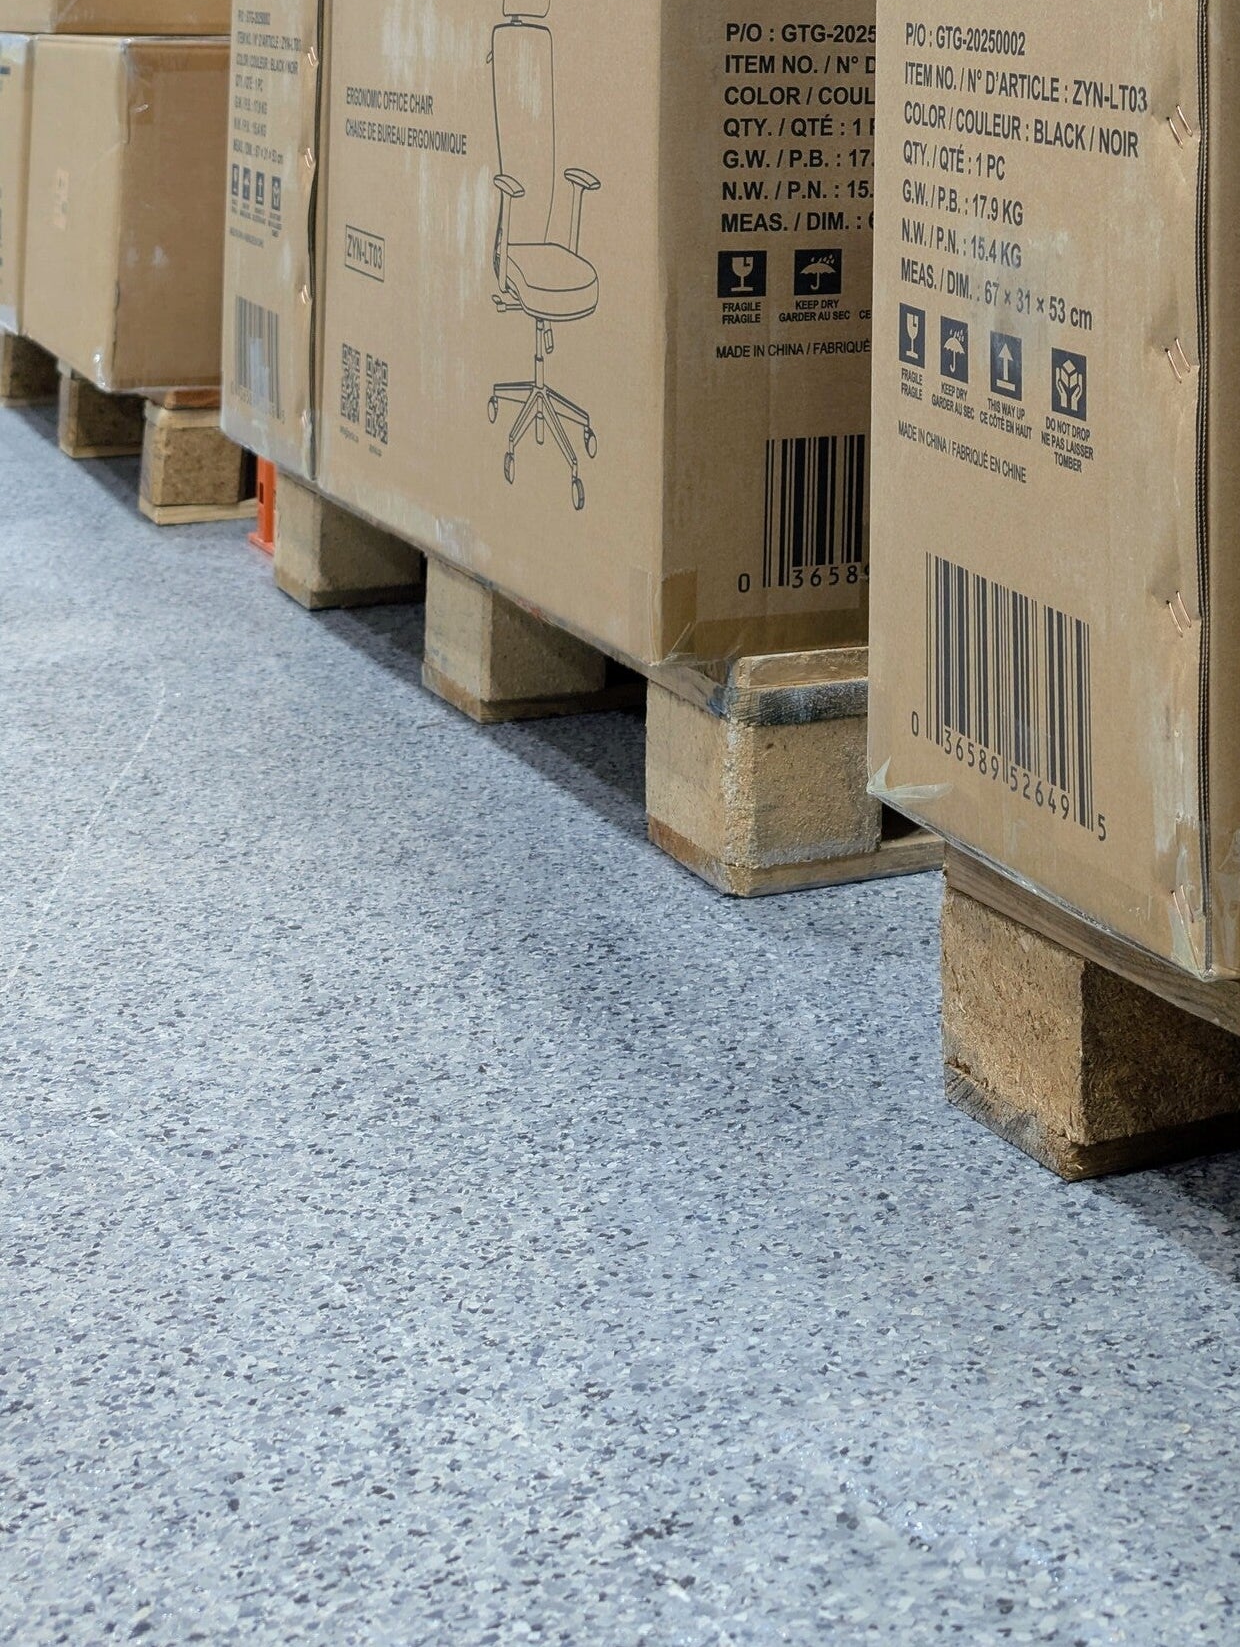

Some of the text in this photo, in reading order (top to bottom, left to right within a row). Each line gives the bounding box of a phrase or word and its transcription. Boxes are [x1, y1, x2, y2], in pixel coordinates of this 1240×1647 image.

[727, 23, 762, 42] P/O
[906, 23, 1026, 55] P/O GTG-20250002
[346, 87, 433, 115] ERGONOMIC OFFICE CHAIR
[905, 61, 932, 87] ITEM
[936, 65, 956, 90] NO.
[1072, 80, 1148, 112] ZYN-LT03
[345, 119, 467, 155] CHAISE DE BUREAU ERGONOMIQUE
[904, 101, 1138, 157] COLOR COULEUR BLACK NOIR
[903, 140, 1005, 180] QTY. QTÉ 1 PC
[347, 233, 383, 270] ZYN-LT03
[795, 299, 840, 310] KEEP DRY
[901, 257, 937, 289] MEAS.
[947, 270, 972, 299] DIM.
[984, 281, 1000, 305] 67
[1016, 288, 1030, 314] 31
[1049, 296, 1066, 323] 53
[1070, 307, 1092, 330] cm
[898, 420, 1026, 483] MADE IN CHINA FABRIQUÉ EN CHINE
[911, 710, 1107, 841] 0 36589 52649 5
